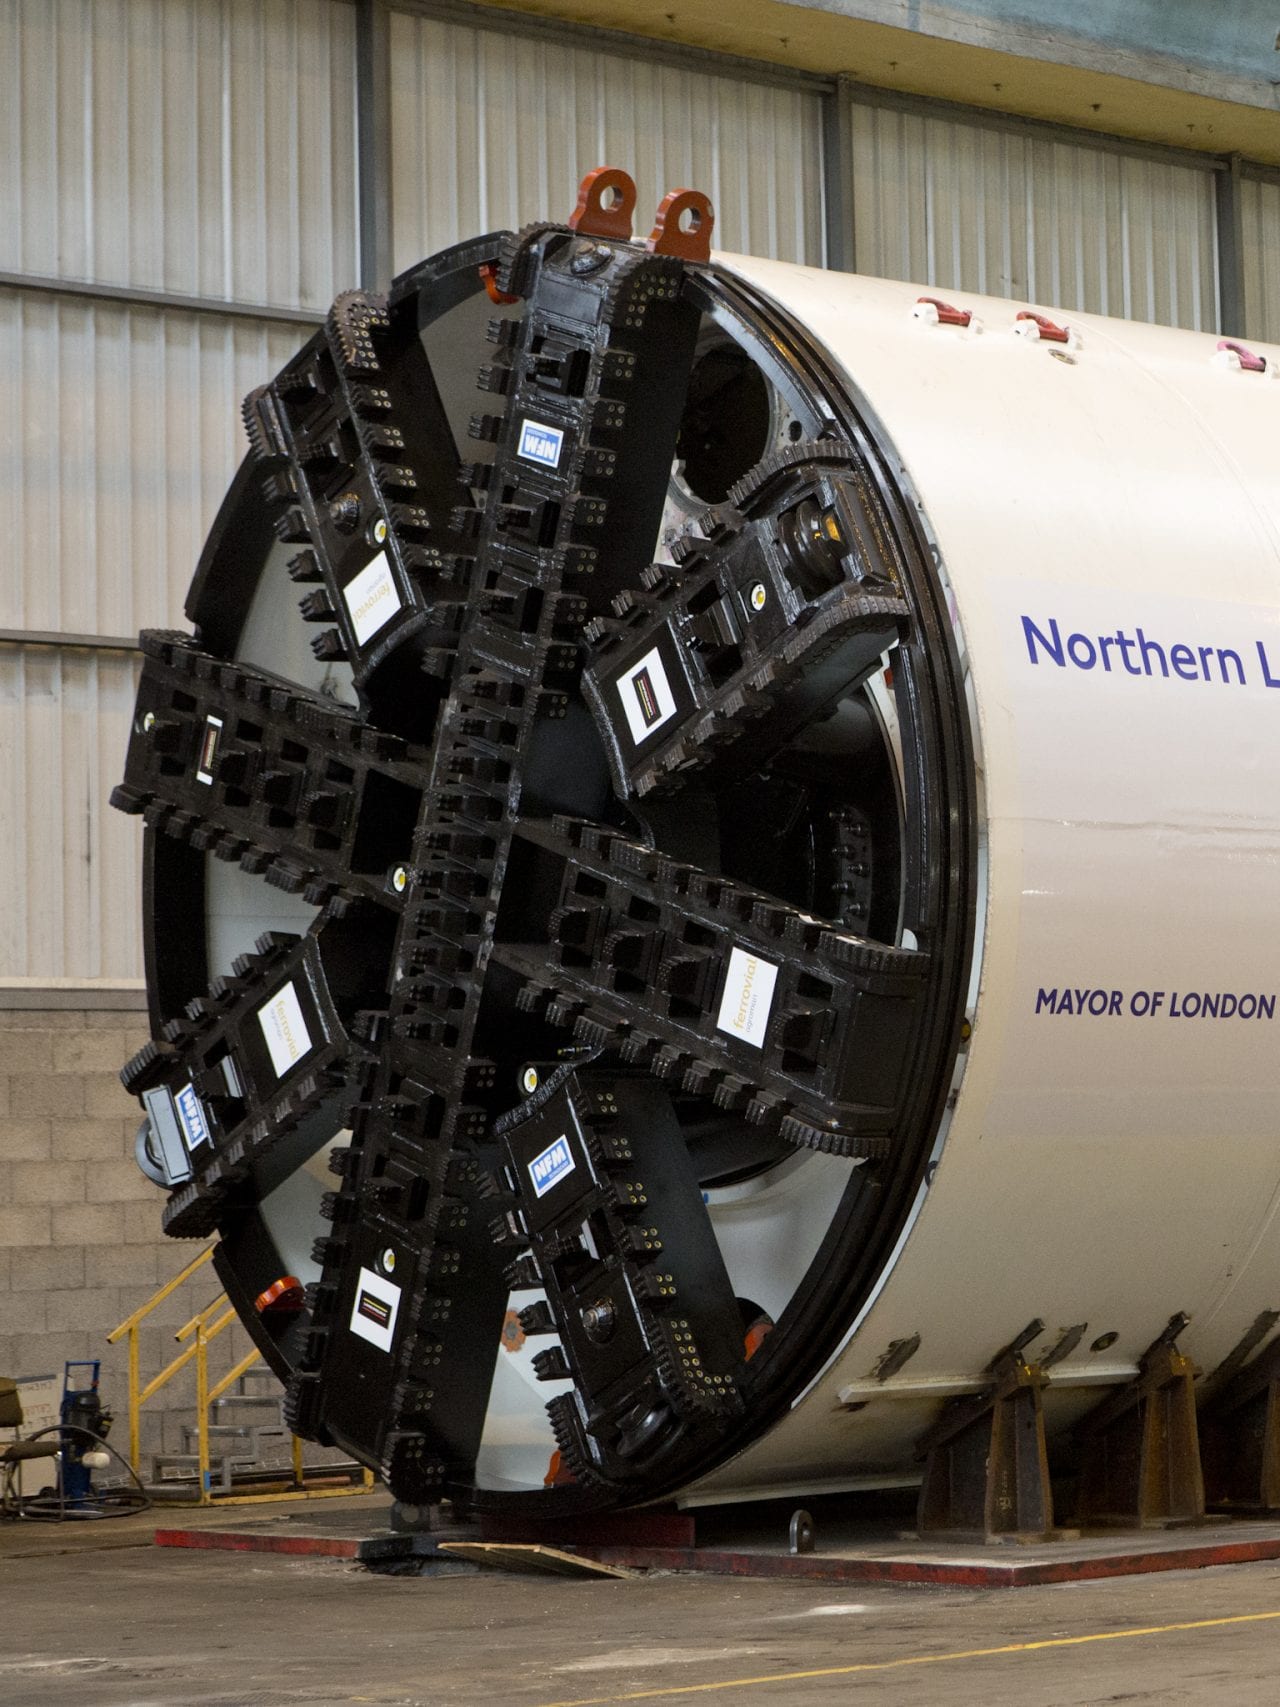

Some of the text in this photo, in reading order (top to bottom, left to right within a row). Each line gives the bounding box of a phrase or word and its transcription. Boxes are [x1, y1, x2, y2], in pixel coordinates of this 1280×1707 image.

[524, 433, 557, 461] NFM
[1020, 615, 1246, 685] Northern
[733, 957, 758, 1030] ferrovial
[1035, 988, 1276, 1019] MAYOR OF LONDON
[275, 999, 299, 1062] ferrovial
[182, 1090, 202, 1139] NFM
[533, 1145, 567, 1182] NFM
